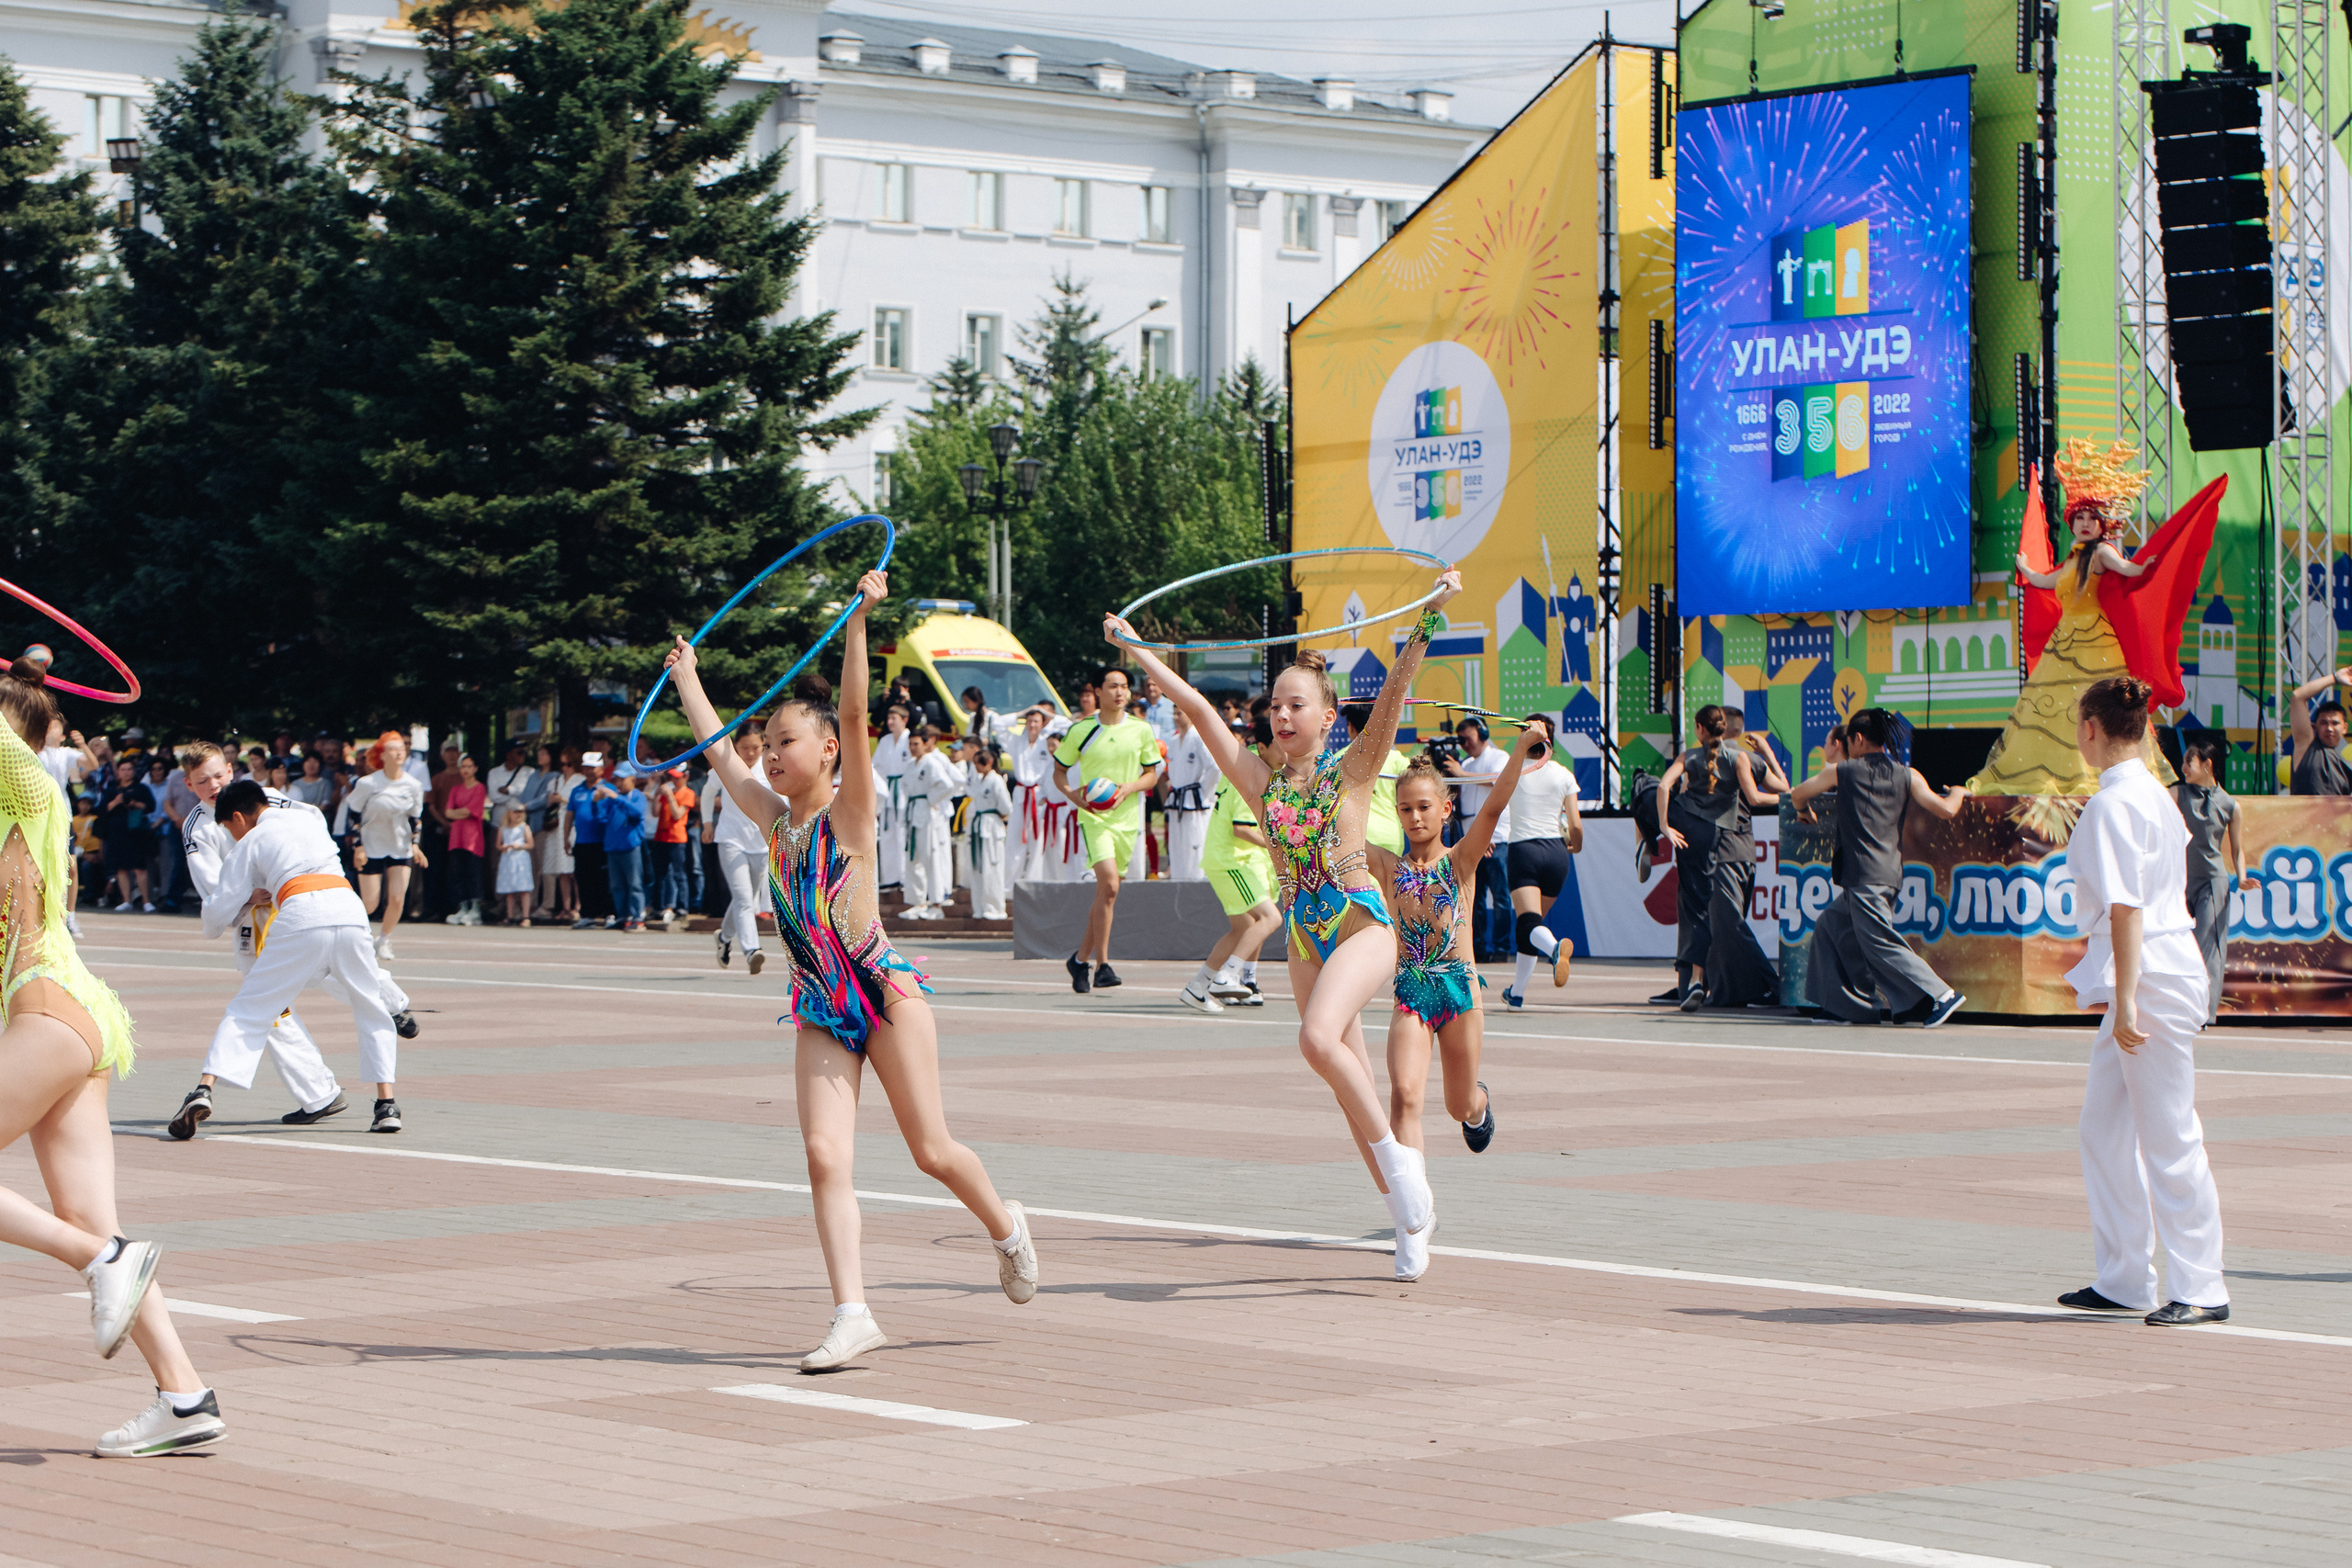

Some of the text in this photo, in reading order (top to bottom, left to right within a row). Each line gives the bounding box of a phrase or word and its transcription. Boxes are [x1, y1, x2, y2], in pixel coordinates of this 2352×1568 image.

[1731, 325, 1911, 378] УЛАН-УДЭ
[1736, 403, 1767, 425] 1666
[1873, 393, 1911, 415] 2022
[1775, 394, 1866, 455] 356
[1395, 440, 1482, 466] УЛАН-УДЭ
